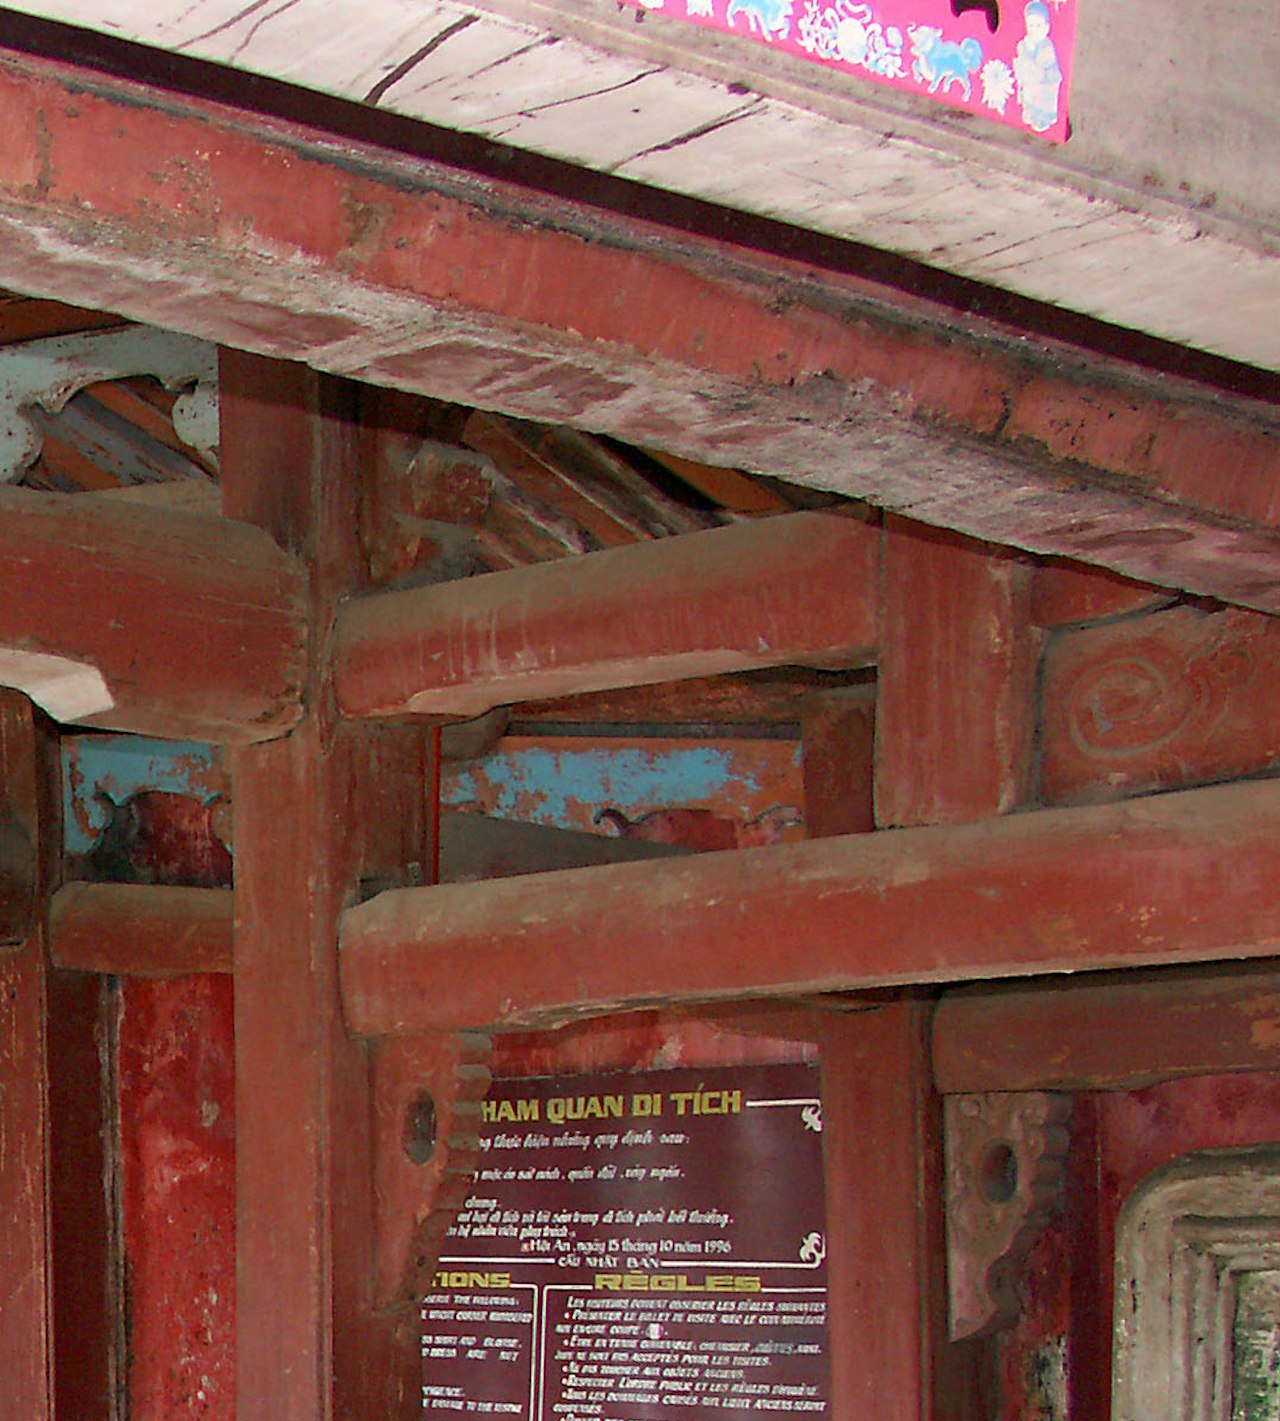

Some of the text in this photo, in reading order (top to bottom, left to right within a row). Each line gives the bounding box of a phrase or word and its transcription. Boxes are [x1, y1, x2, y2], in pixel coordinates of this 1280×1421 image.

[480, 1082, 742, 1125] HAM QUAN DI TÍCH
[594, 1133, 618, 1150] quy
[607, 1238, 620, 1252] 15
[659, 1239, 674, 1252] 10
[704, 1239, 732, 1254] 1996
